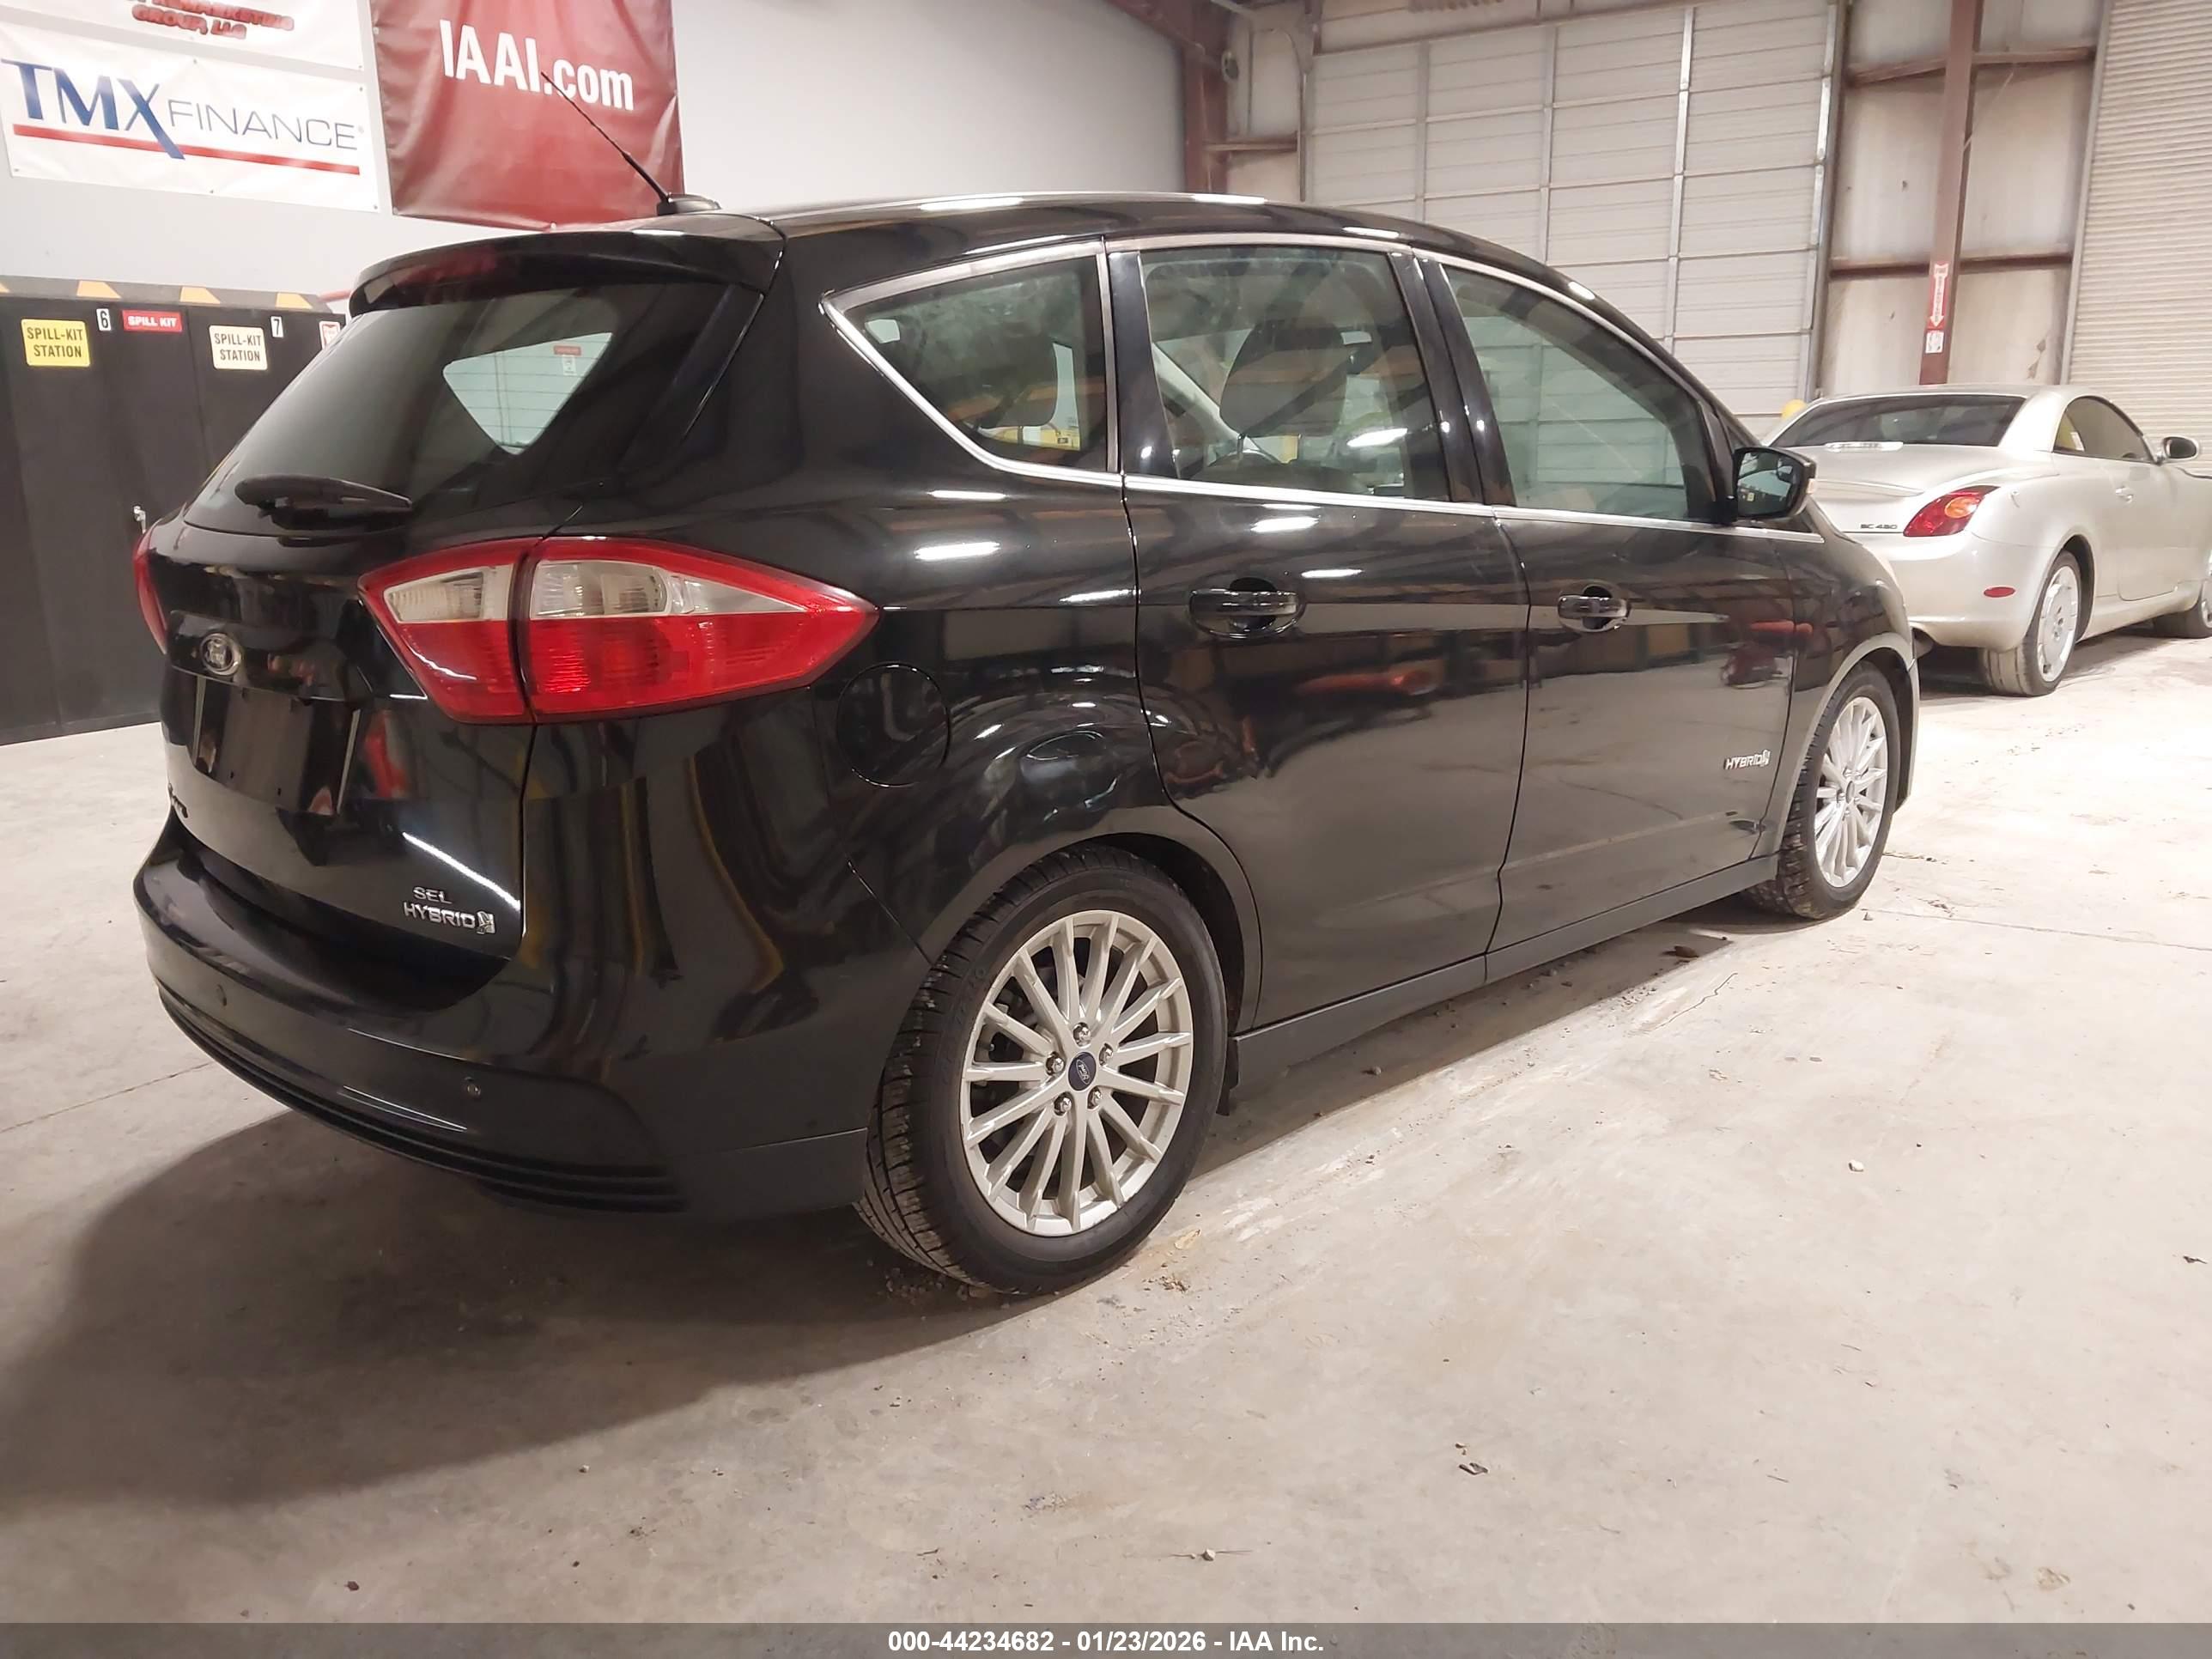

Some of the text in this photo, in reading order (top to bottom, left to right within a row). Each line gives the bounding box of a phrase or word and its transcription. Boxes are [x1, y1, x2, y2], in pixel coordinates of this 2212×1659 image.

[439, 19, 635, 111] IAAI.com
[100, 310, 109, 329] 6
[127, 315, 177, 328] SPILL KIT
[273, 318, 280, 336] 7
[27, 326, 83, 341] SPILL-KIT
[214, 332, 262, 346] SPILL-KIT
[33, 343, 82, 357] STATION
[220, 349, 261, 362] STATION
[1724, 754, 1763, 769] HYBRID
[413, 886, 453, 904] SEL
[404, 902, 476, 928] HYBRID
